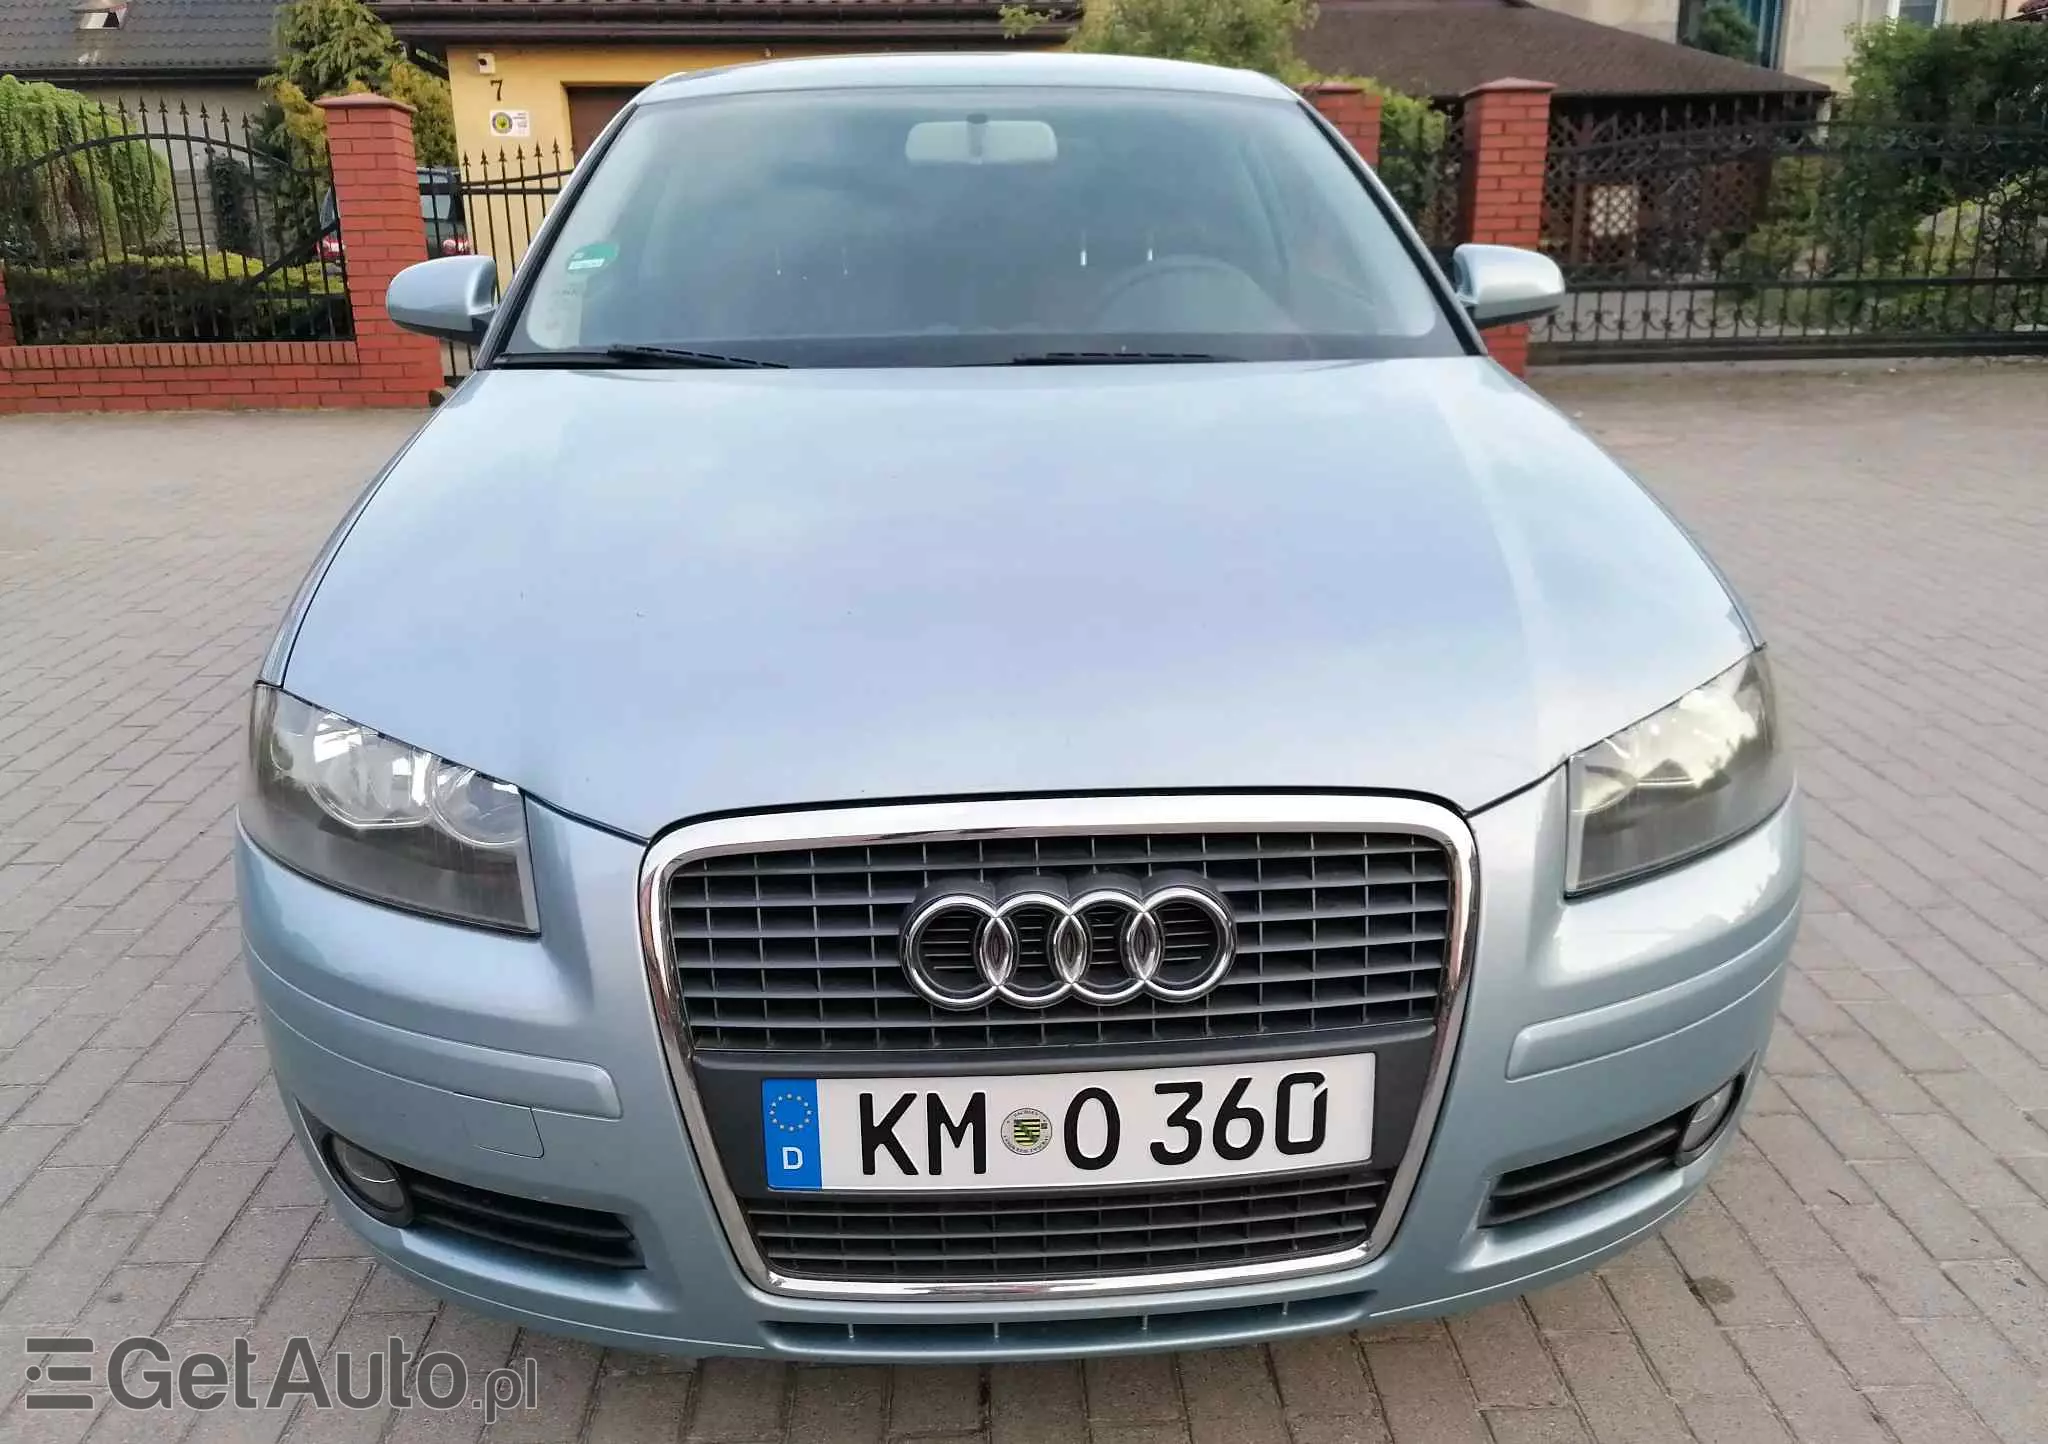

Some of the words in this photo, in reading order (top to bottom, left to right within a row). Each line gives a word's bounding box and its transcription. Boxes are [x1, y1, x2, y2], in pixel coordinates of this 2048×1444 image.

[490, 79, 503, 101] 7
[859, 1092, 986, 1176] KM
[1063, 1087, 1121, 1171] O
[1149, 1071, 1329, 1166] 360
[782, 1147, 803, 1170] D
